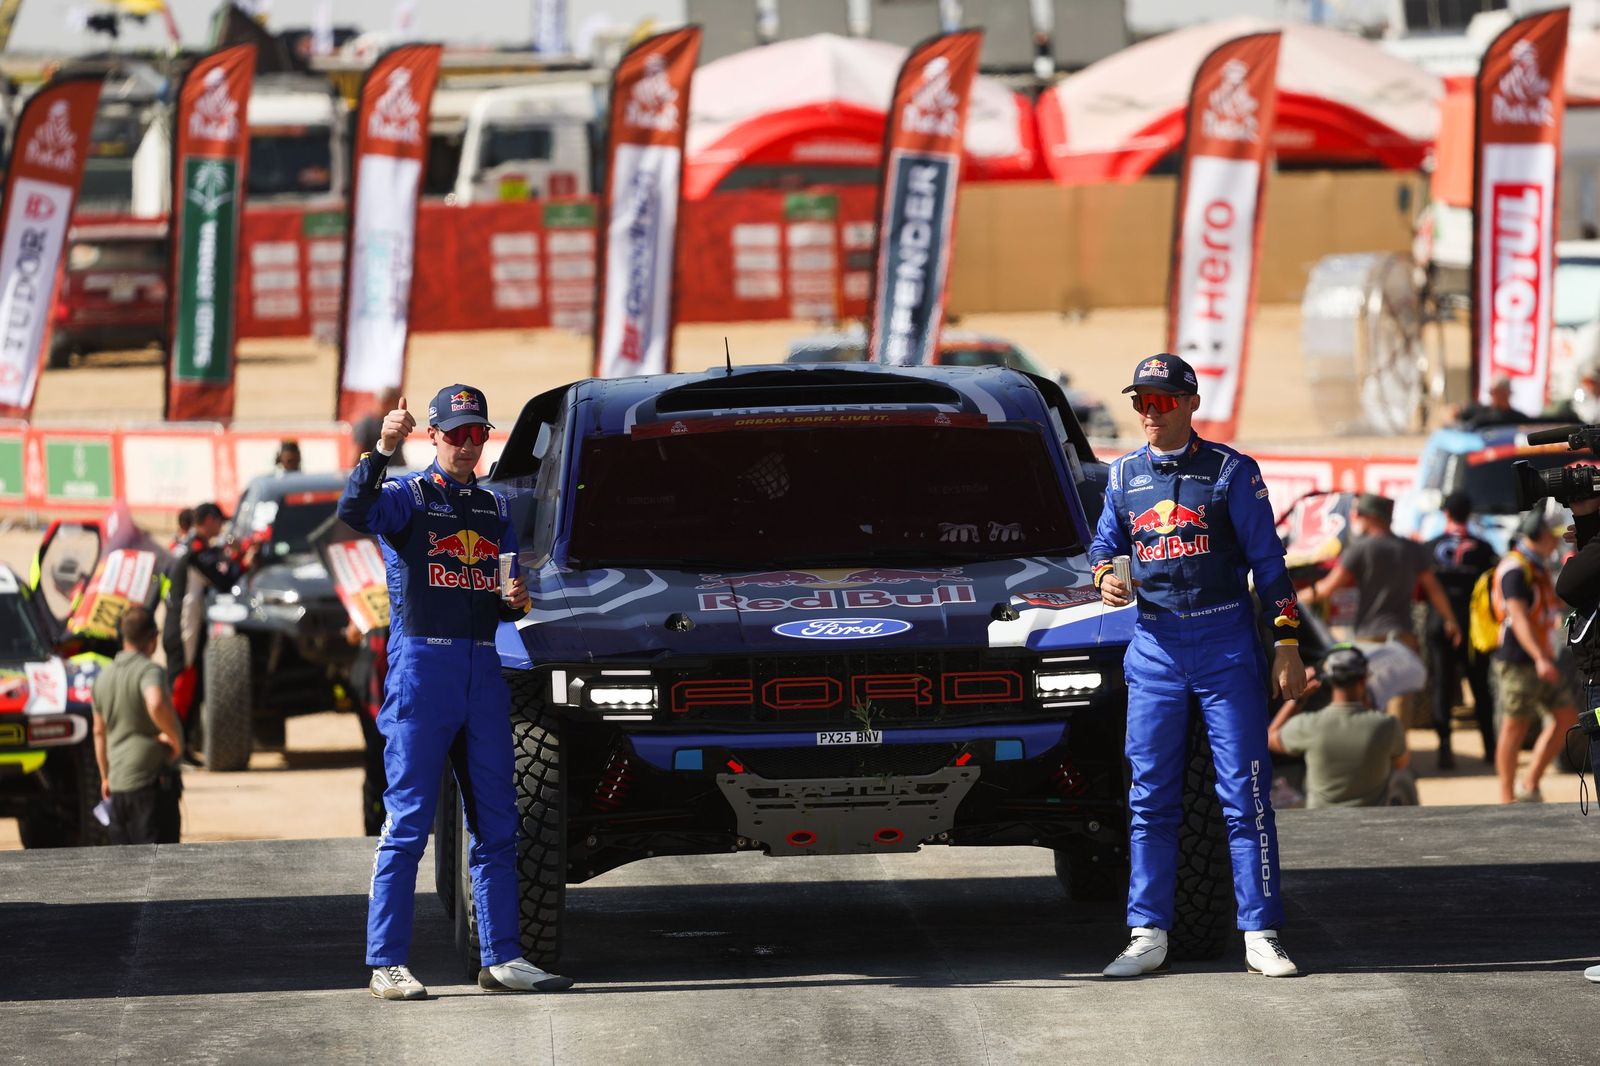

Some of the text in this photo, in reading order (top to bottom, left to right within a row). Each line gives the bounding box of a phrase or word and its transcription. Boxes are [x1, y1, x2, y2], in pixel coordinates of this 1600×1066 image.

[1195, 199, 1236, 321] Hero
[1493, 187, 1539, 374] MOTUL
[735, 417, 790, 426] DREAM.
[1128, 486, 1154, 494] RACING
[1178, 474, 1212, 482] RAPTOR
[1135, 535, 1211, 563] Red Bull
[428, 562, 471, 590] Red
[471, 567, 499, 592] Bul
[698, 585, 976, 612] Red Bull
[427, 637, 452, 645] sparco
[801, 618, 884, 637] Ford
[671, 671, 1023, 712] FORD
[820, 731, 880, 744] PX25 BNV
[1259, 832, 1272, 898] FORD
